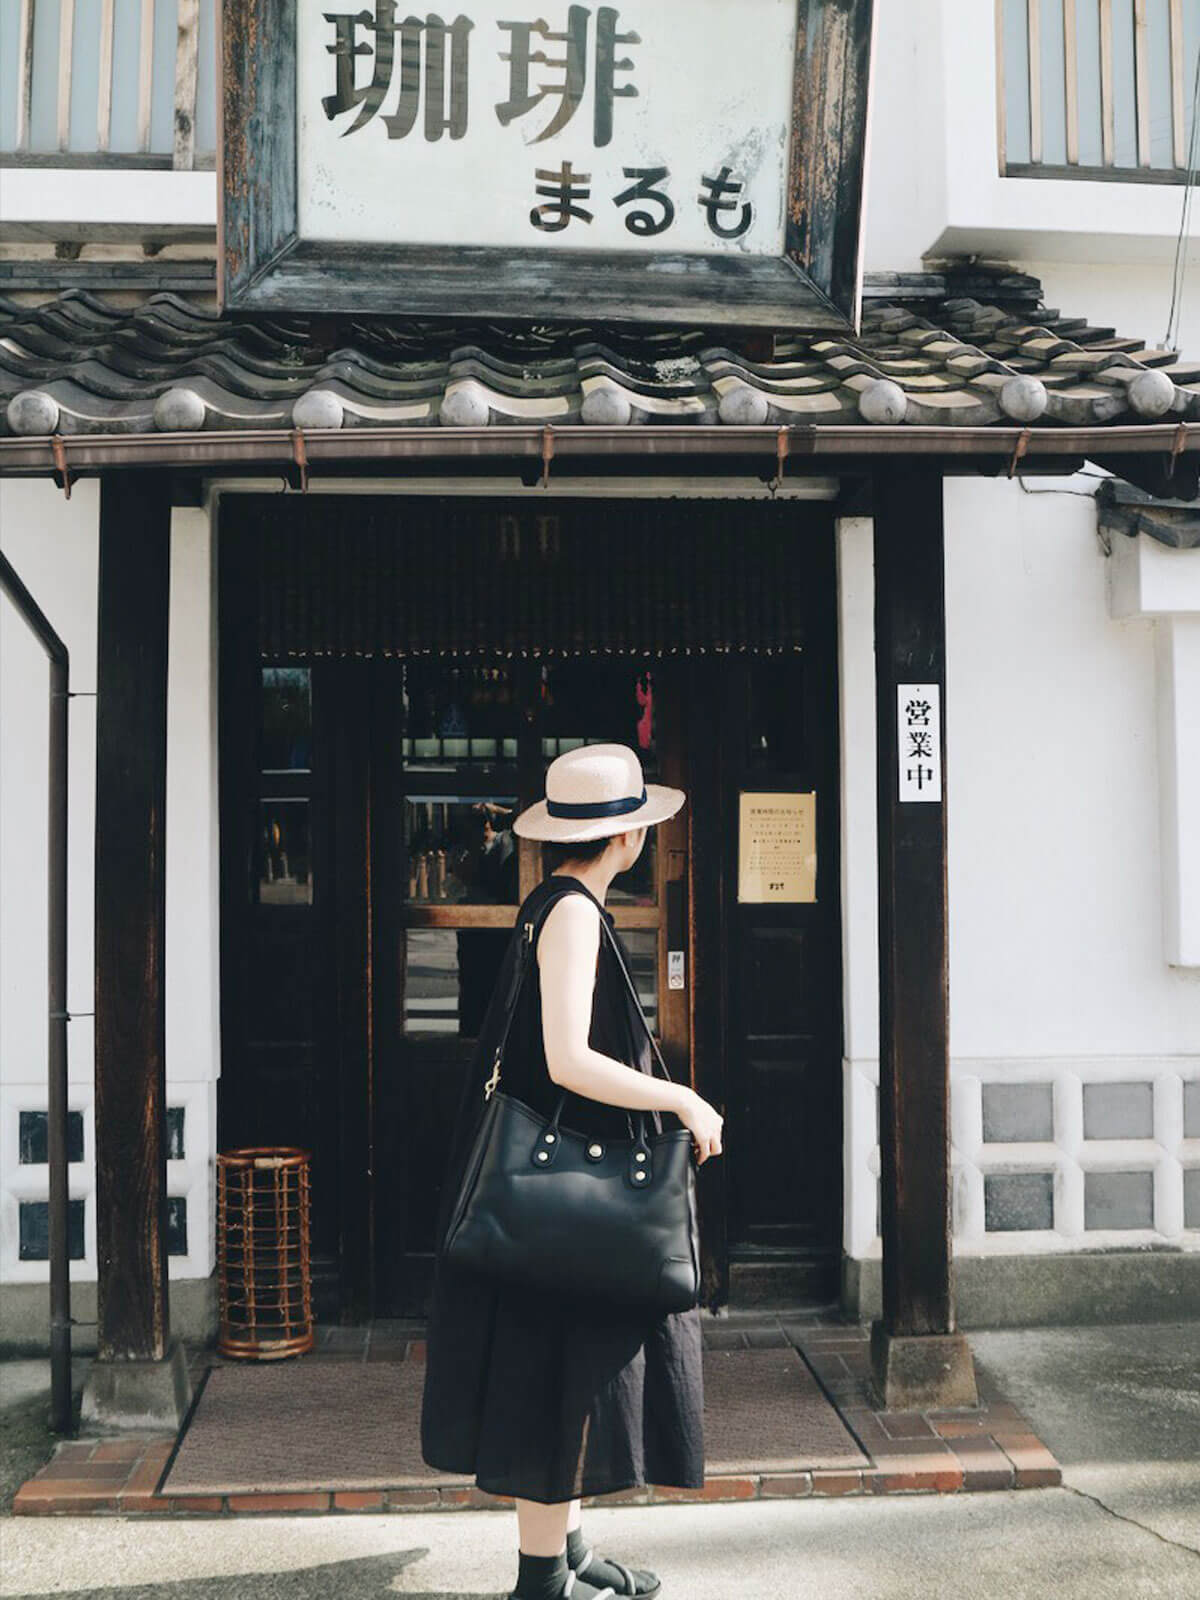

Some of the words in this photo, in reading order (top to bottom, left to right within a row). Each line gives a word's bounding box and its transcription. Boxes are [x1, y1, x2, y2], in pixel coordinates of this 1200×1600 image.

[321, 0, 641, 148] 珈琲
[529, 160, 753, 239] まるも
[905, 699, 933, 790] 営業中
